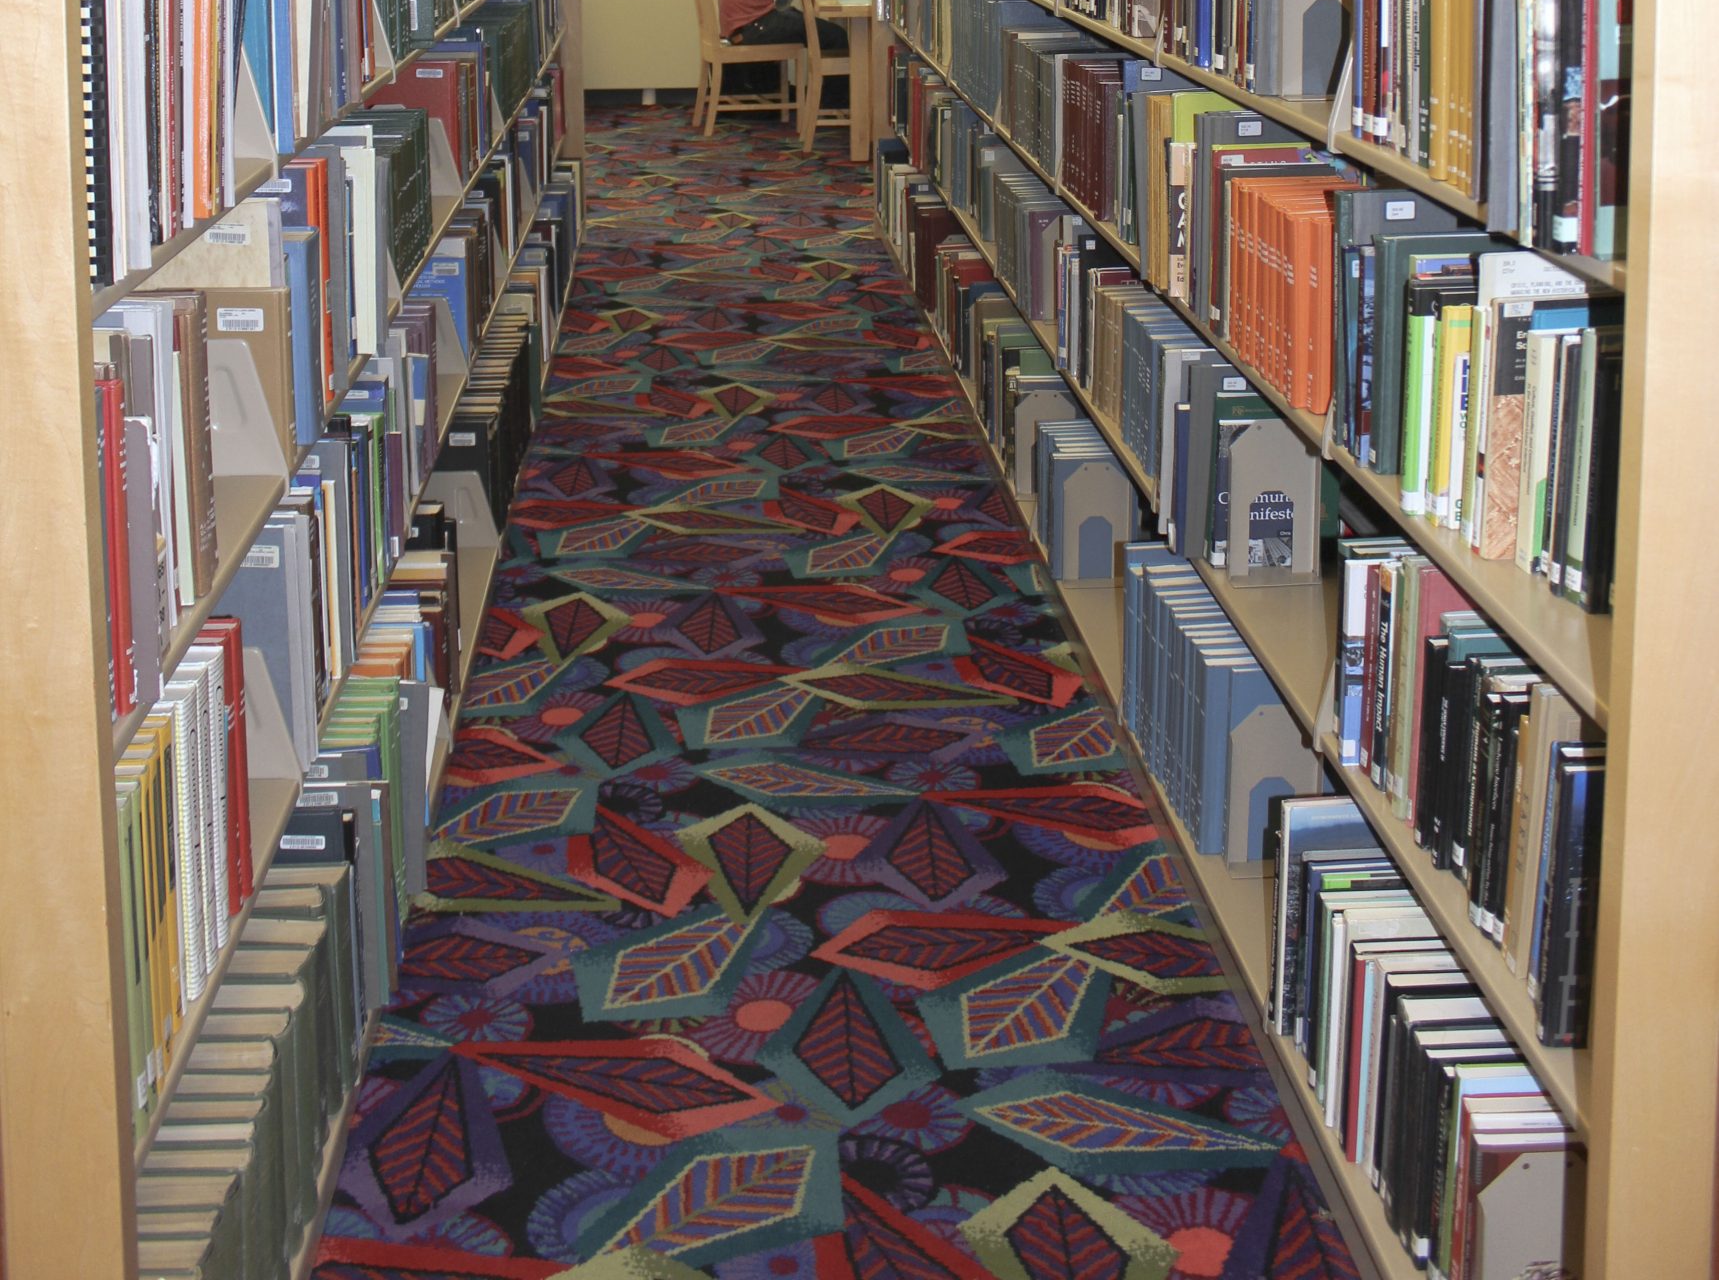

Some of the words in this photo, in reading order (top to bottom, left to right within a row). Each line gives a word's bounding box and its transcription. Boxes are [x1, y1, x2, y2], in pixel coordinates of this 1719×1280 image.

[1361, 8, 1371, 98] Communities
[1380, 621, 1389, 643] The
[1377, 645, 1388, 689] Human
[215, 685, 226, 784] Consumers
[1375, 691, 1386, 733] Impact
[202, 709, 212, 810] Consumers
[1473, 721, 1481, 762] Humans
[189, 728, 200, 832] Consumers
[1491, 777, 1500, 811] Interfaces
[1544, 769, 1557, 808] Human
[220, 795, 228, 842] Index
[1467, 777, 1477, 837] Components
[206, 822, 215, 873] Index
[1515, 793, 1530, 872] EARTH
[1540, 810, 1554, 860] Ecology
[194, 842, 203, 893] Index
